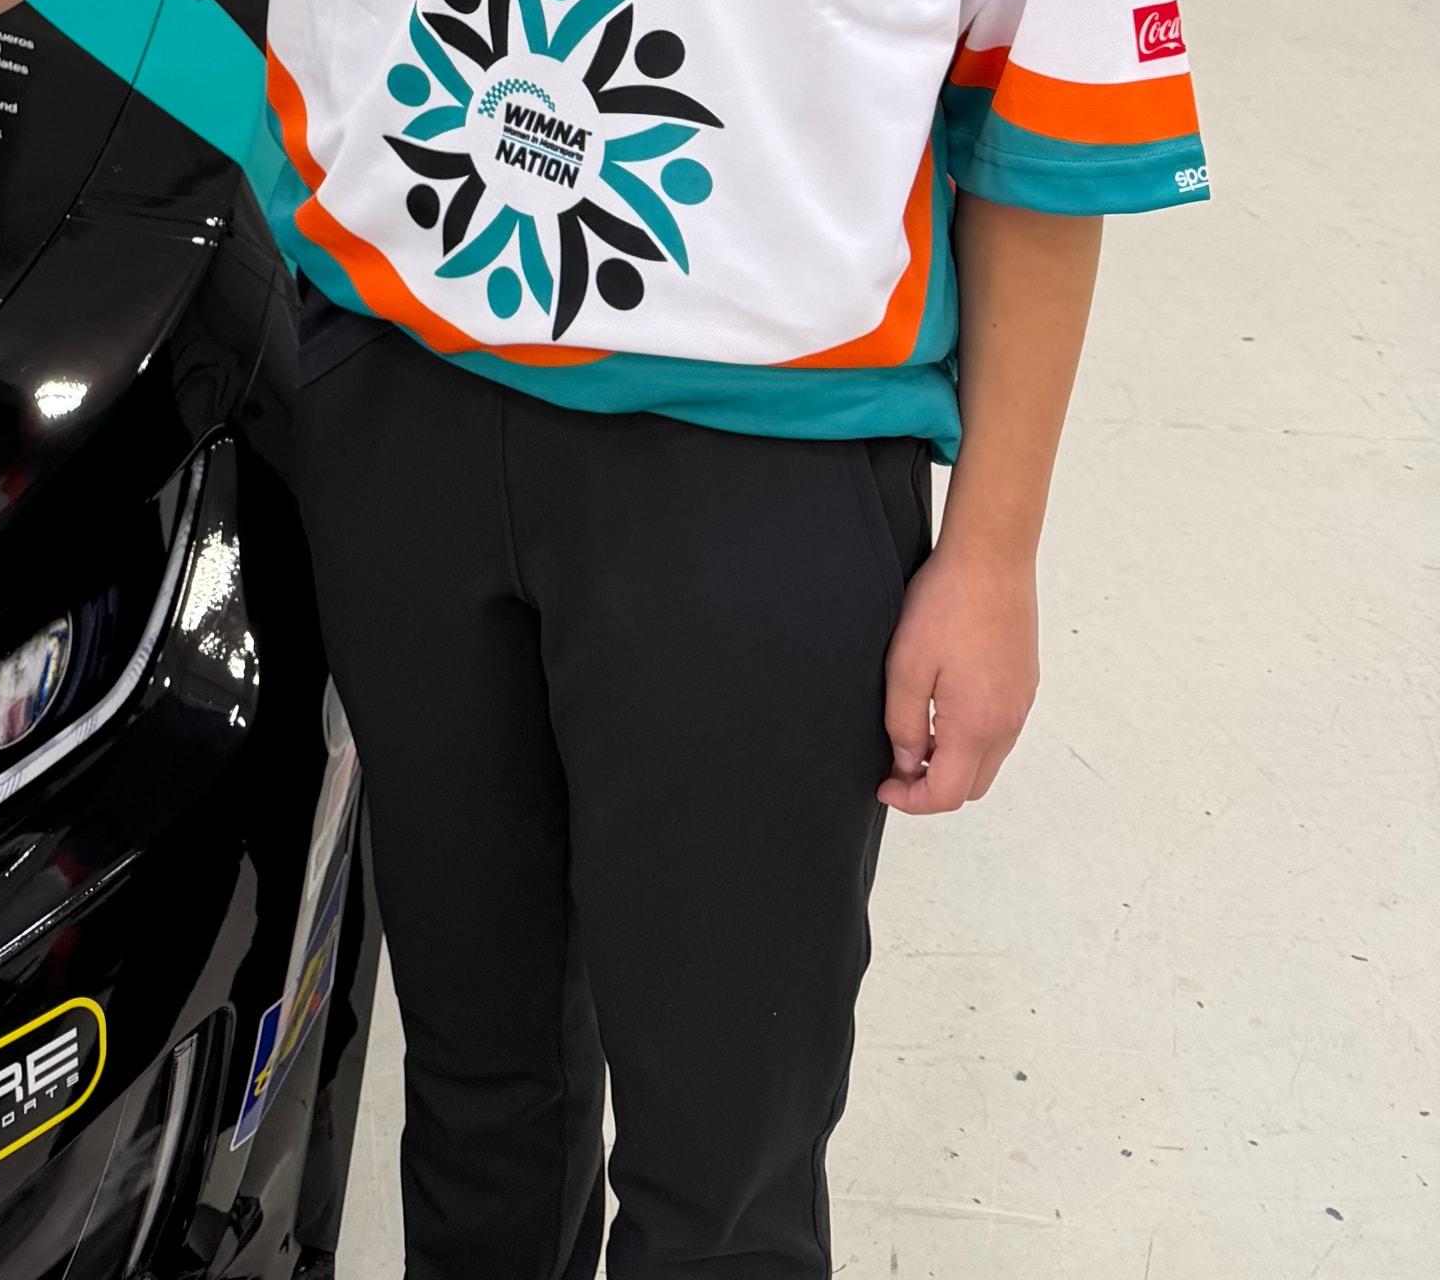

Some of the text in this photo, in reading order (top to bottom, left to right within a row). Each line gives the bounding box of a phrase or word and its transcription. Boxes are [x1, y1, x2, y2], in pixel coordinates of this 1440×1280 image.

[1140, 11, 1181, 53] Coca
[504, 102, 586, 152] WIMNA
[495, 138, 580, 189] NATION
[1174, 165, 1210, 192] spa
